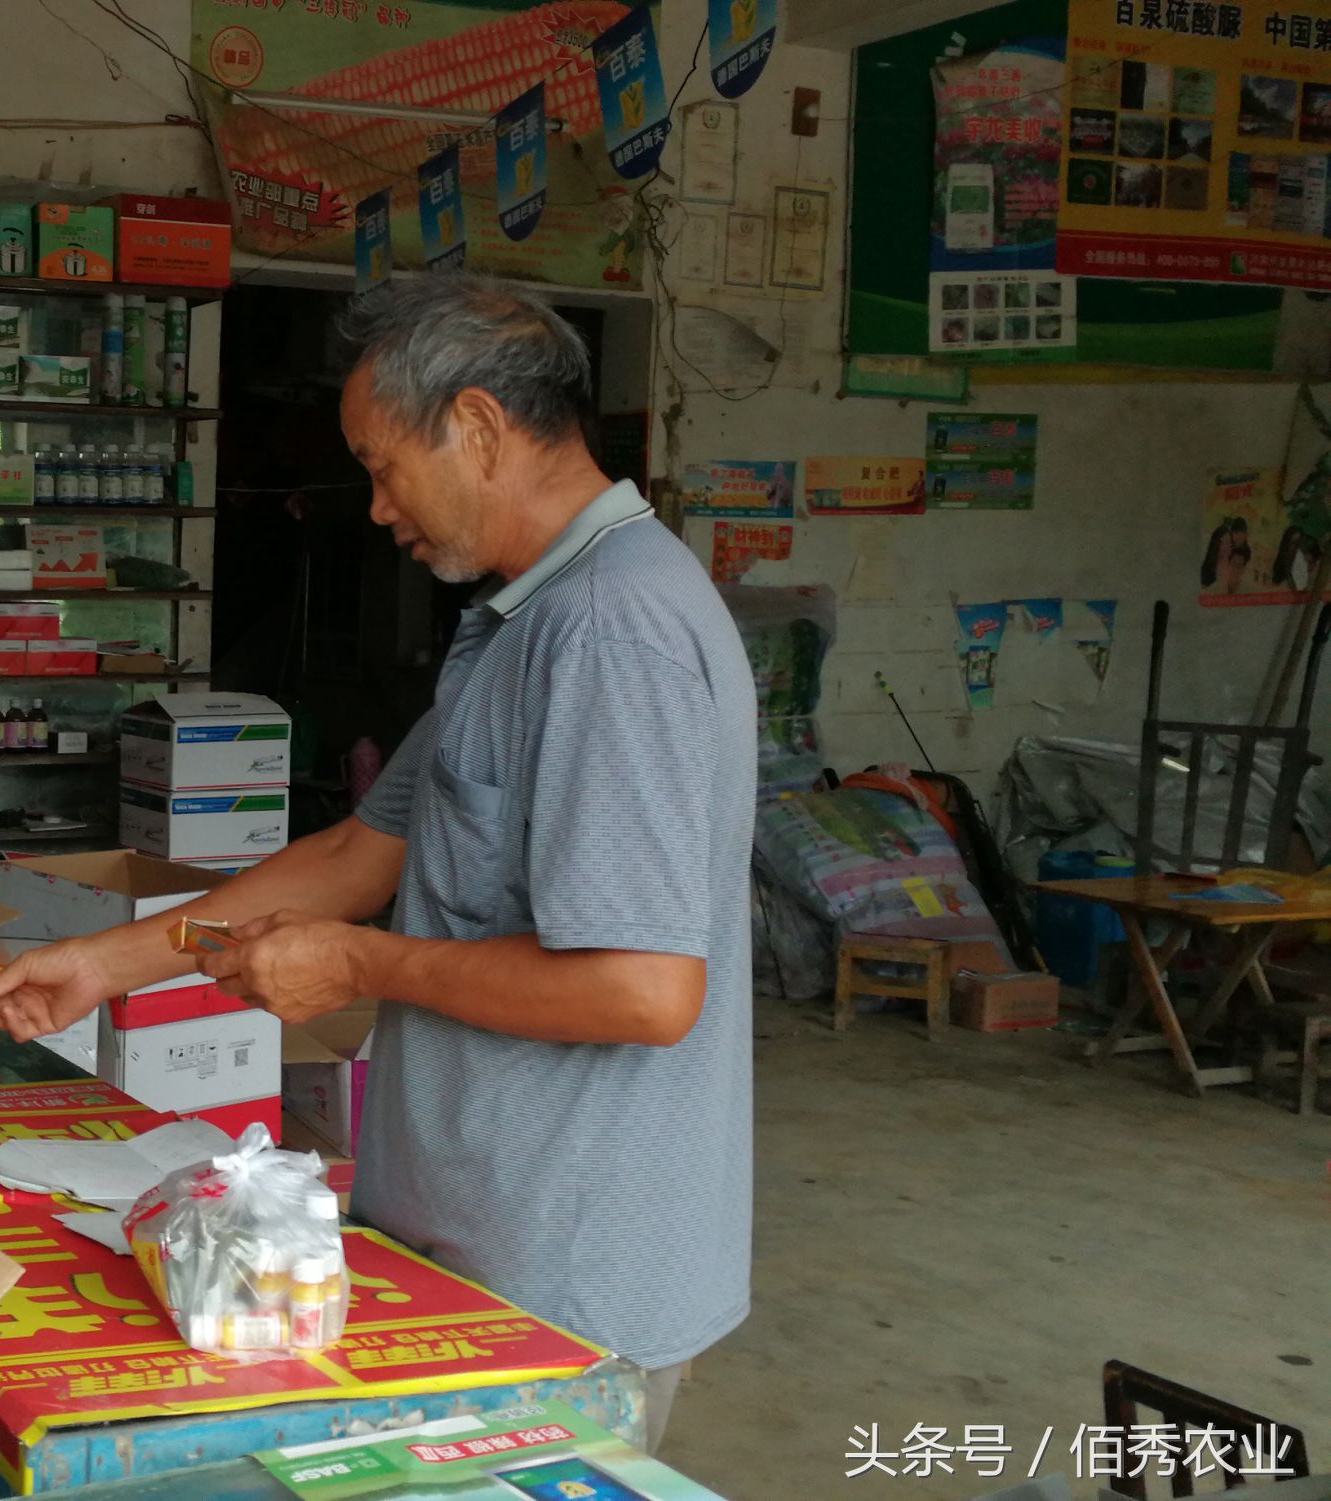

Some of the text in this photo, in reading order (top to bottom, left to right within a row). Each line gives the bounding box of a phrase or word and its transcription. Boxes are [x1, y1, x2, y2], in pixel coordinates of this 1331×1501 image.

[717, 38, 771, 87] 德国巴斯夫
[614, 127, 664, 168] 德国巴斯夫
[230, 170, 320, 212] 农业部重点
[516, 1426, 570, 1445] 药材
[289, 1462, 353, 1483] BASF
